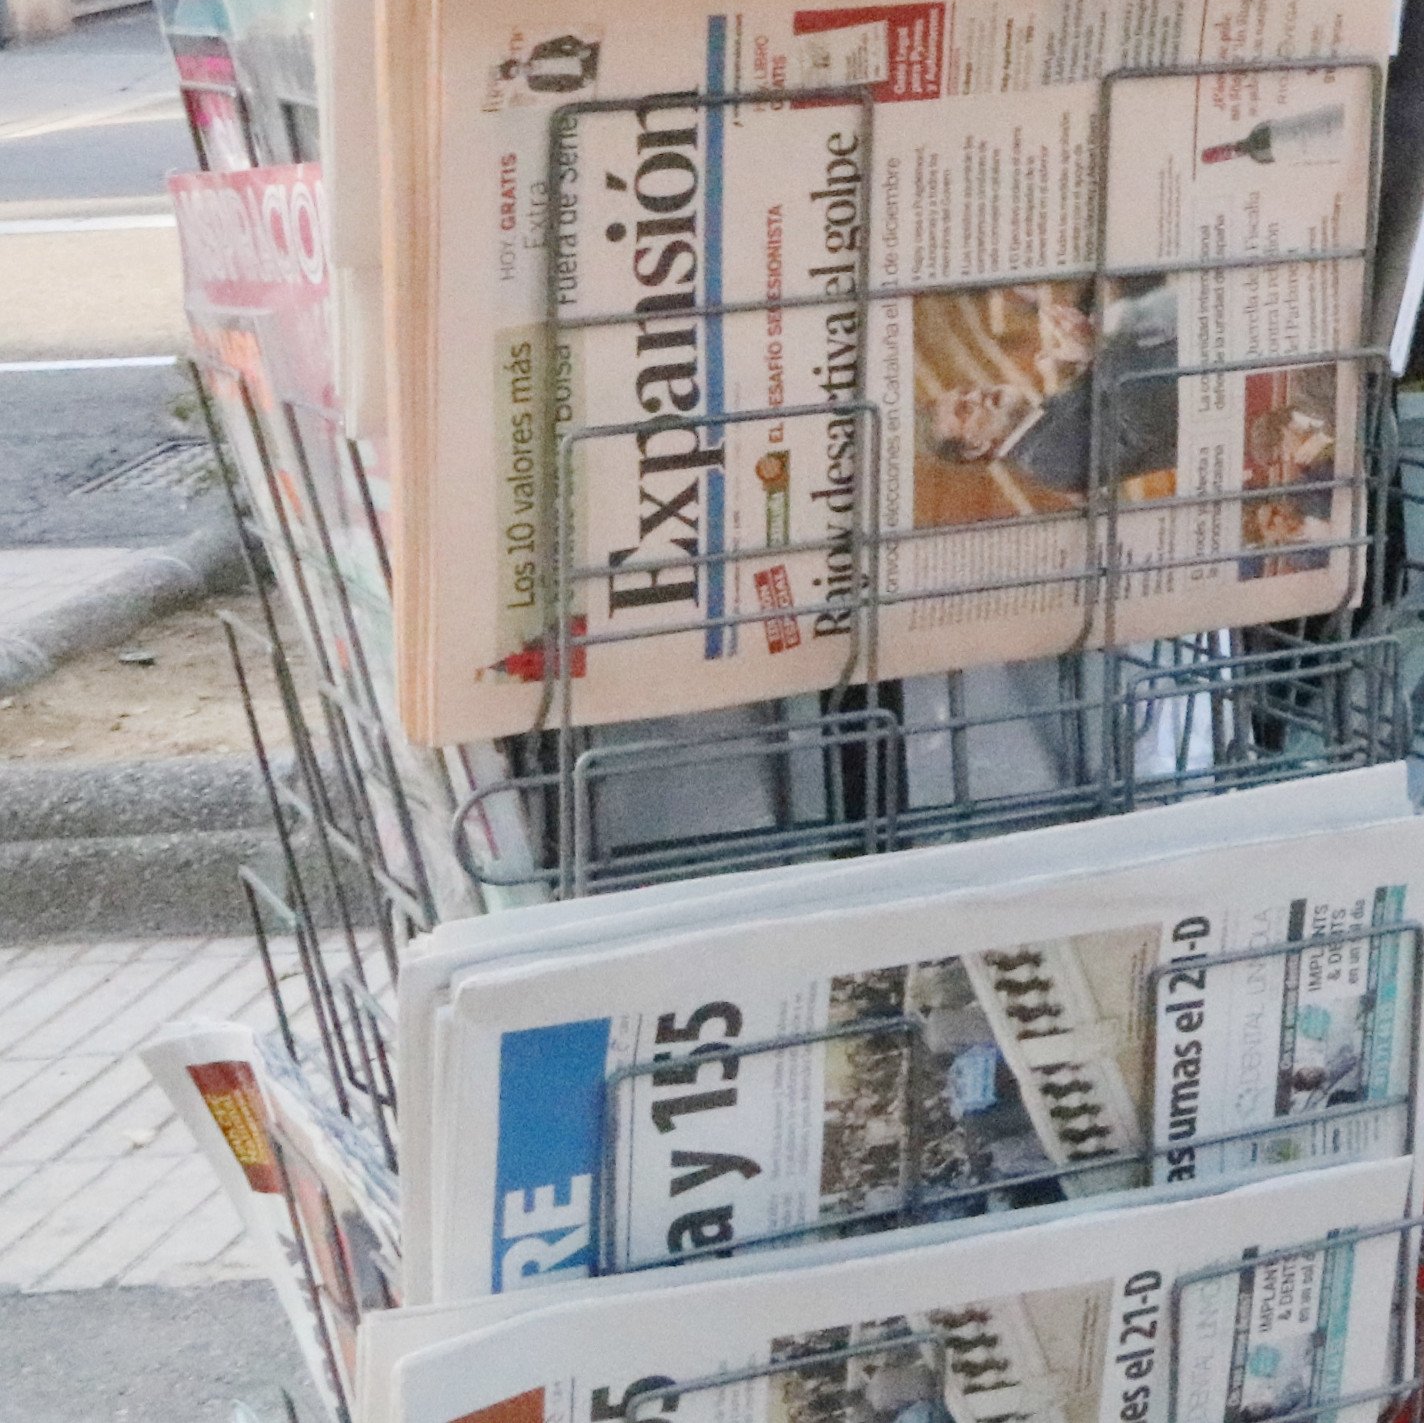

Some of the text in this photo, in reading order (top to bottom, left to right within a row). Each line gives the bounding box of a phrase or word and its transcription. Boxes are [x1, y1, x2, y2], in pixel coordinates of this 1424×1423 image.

[769, 54, 786, 112] GATIS
[499, 152, 517, 231] GRATIS
[524, 180, 547, 249] Extra
[809, 131, 862, 254] golpe
[808, 263, 858, 295] el
[604, 83, 728, 620] Expansión
[763, 342, 784, 416] ESAFÍO
[503, 341, 535, 610] Los 10 valores más
[1166, 915, 1211, 994] 21-D
[1306, 903, 1329, 992] IMPLNTS
[1165, 998, 1205, 1033] el
[649, 1000, 744, 1135] 155
[1114, 1269, 1163, 1423] es el 21-D
